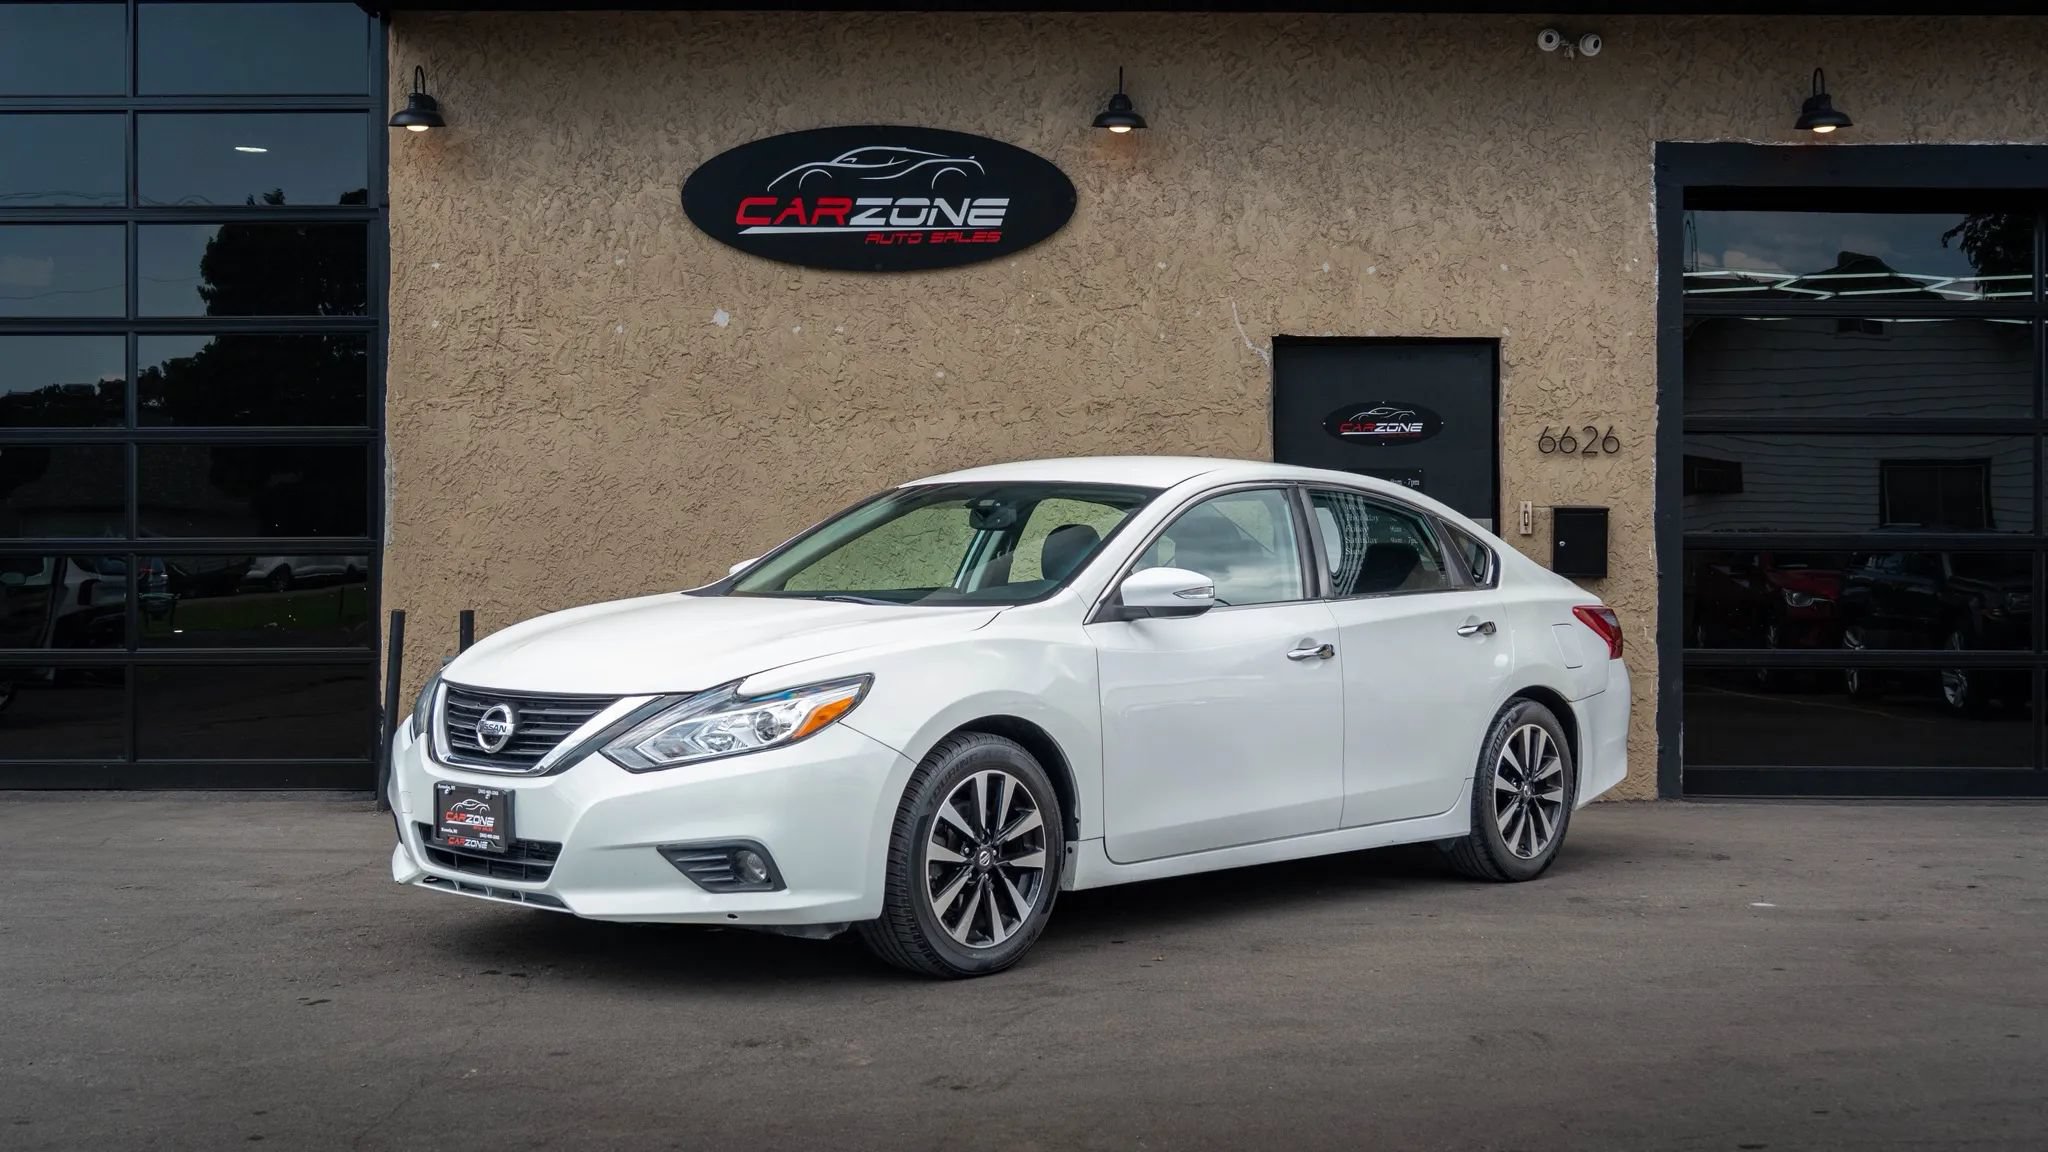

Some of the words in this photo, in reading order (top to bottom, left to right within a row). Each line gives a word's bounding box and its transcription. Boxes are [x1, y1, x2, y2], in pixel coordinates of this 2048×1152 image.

[735, 197, 1010, 227] CARZONE
[864, 232, 923, 245] AUTO
[929, 231, 1001, 244] SALES
[1339, 422, 1424, 433] CARZONE
[1538, 425, 1620, 454] 6626
[1408, 478, 1419, 487] 7pm
[926, 753, 978, 809] TOURING
[445, 810, 495, 827] CARZONE
[448, 836, 488, 849] CARZONE
